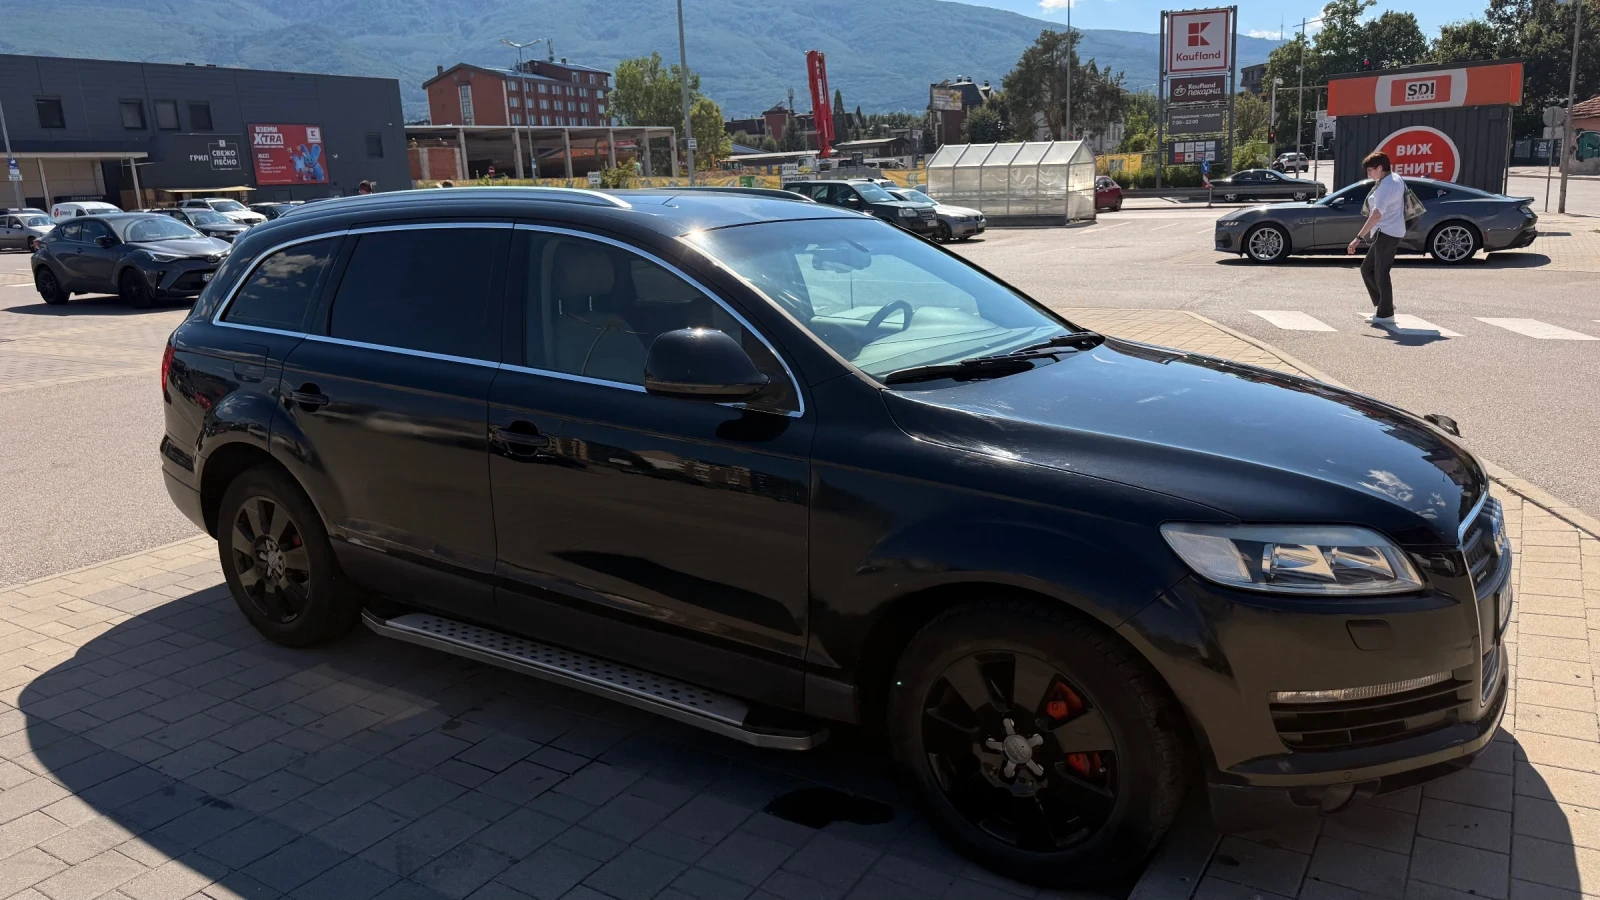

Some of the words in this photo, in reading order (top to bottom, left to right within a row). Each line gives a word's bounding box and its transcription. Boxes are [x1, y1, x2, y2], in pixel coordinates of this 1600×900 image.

[1176, 50, 1221, 61] Kaufland
[1188, 82, 1216, 90] Kaufland
[1407, 82, 1435, 96] SDI
[1188, 88, 1221, 96] пекарна
[1396, 143, 1433, 156] ВИЖ
